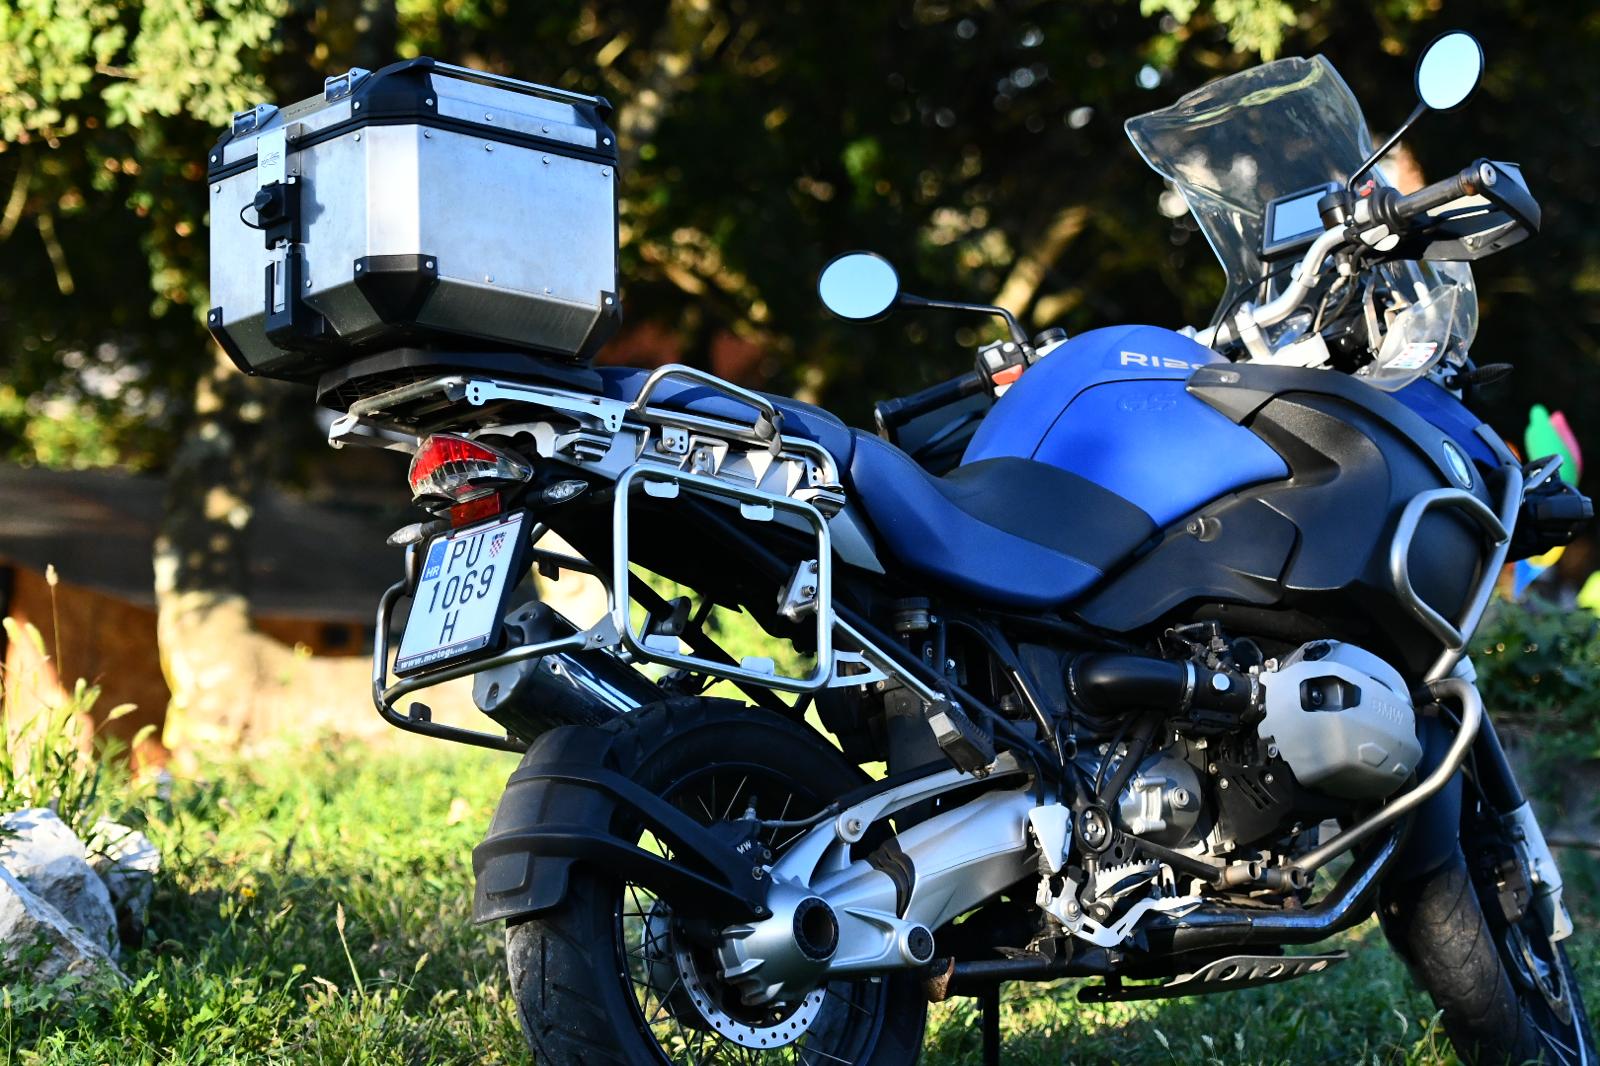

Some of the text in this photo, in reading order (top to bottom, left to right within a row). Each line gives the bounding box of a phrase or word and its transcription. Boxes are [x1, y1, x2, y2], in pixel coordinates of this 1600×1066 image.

[447, 534, 485, 574] PU
[425, 566, 440, 579] HR
[429, 564, 495, 613] 1069
[439, 609, 459, 645] H
[1371, 698, 1404, 726] BMW
